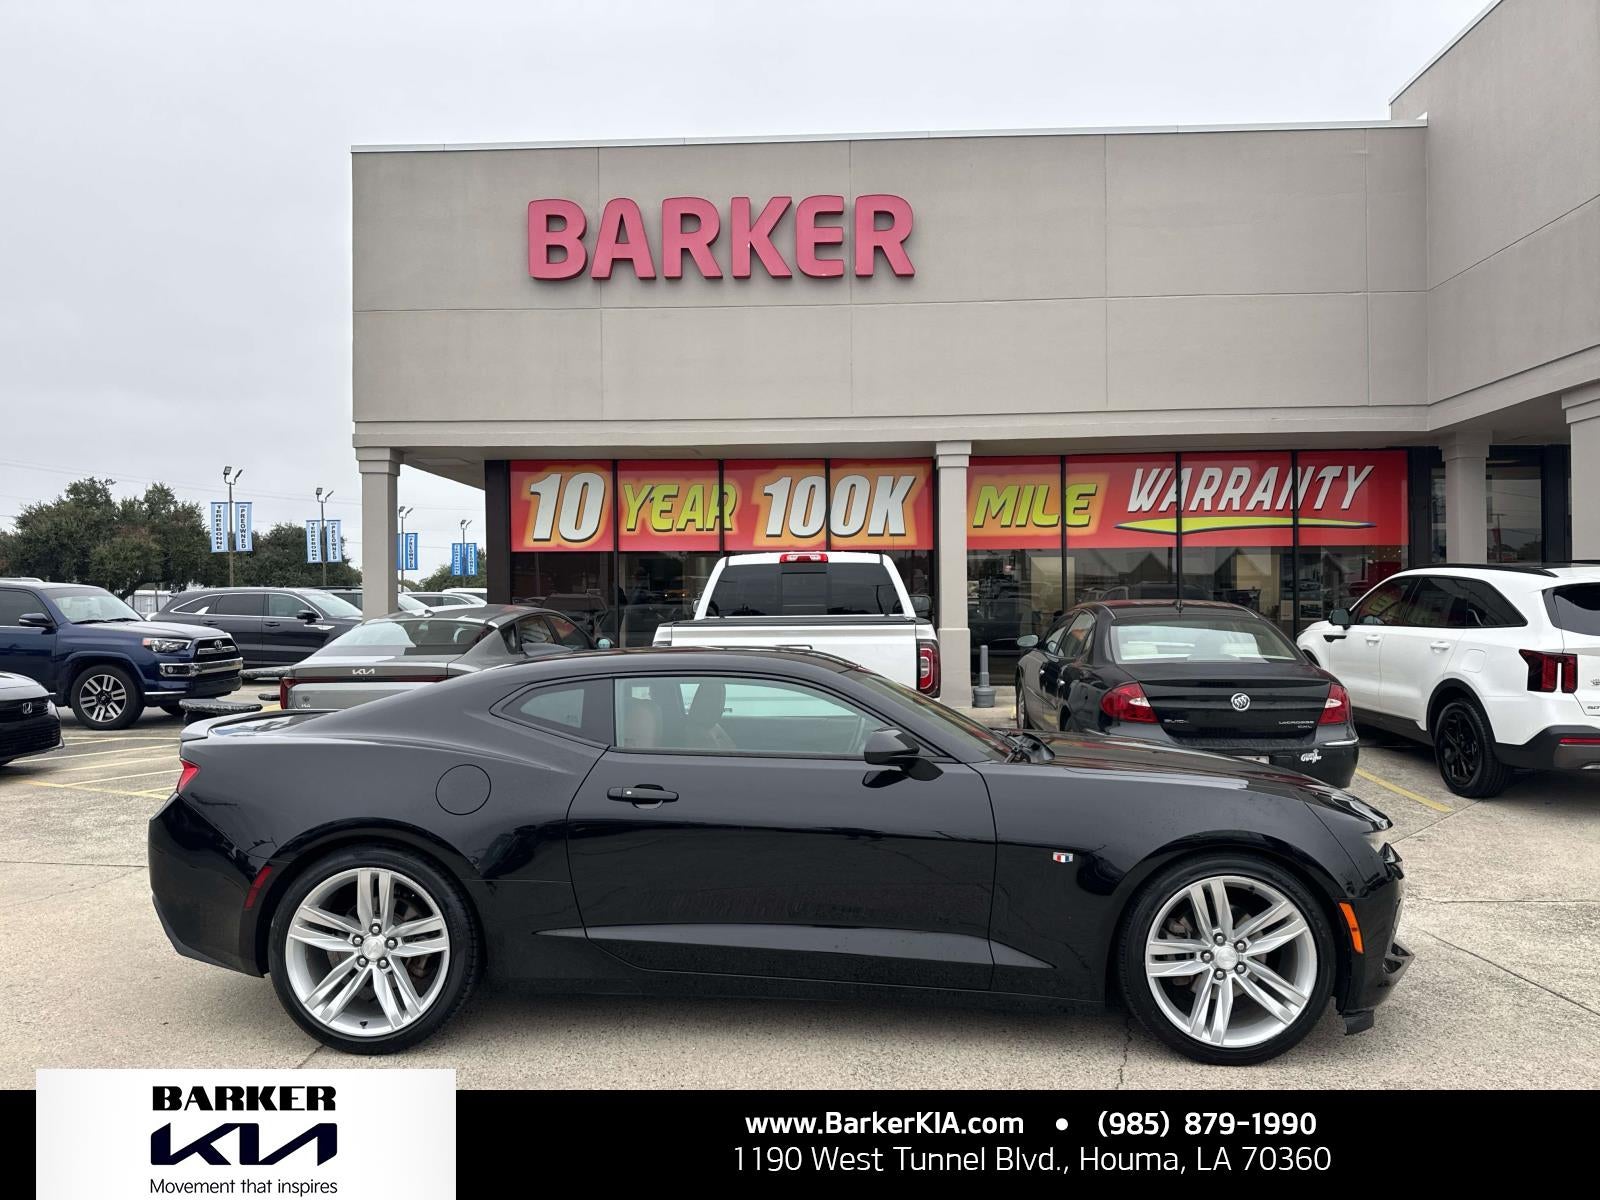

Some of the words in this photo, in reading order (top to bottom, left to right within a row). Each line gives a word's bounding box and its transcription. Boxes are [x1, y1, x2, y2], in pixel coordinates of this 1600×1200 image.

[527, 194, 915, 280] BARKER
[215, 505, 223, 550] TERREBONNE
[530, 472, 606, 542] 10
[623, 483, 738, 532] YEAR
[764, 474, 917, 538] 100K
[973, 483, 1098, 528] MILE
[1127, 465, 1375, 513] WARRANTY
[352, 667, 376, 675] KIA
